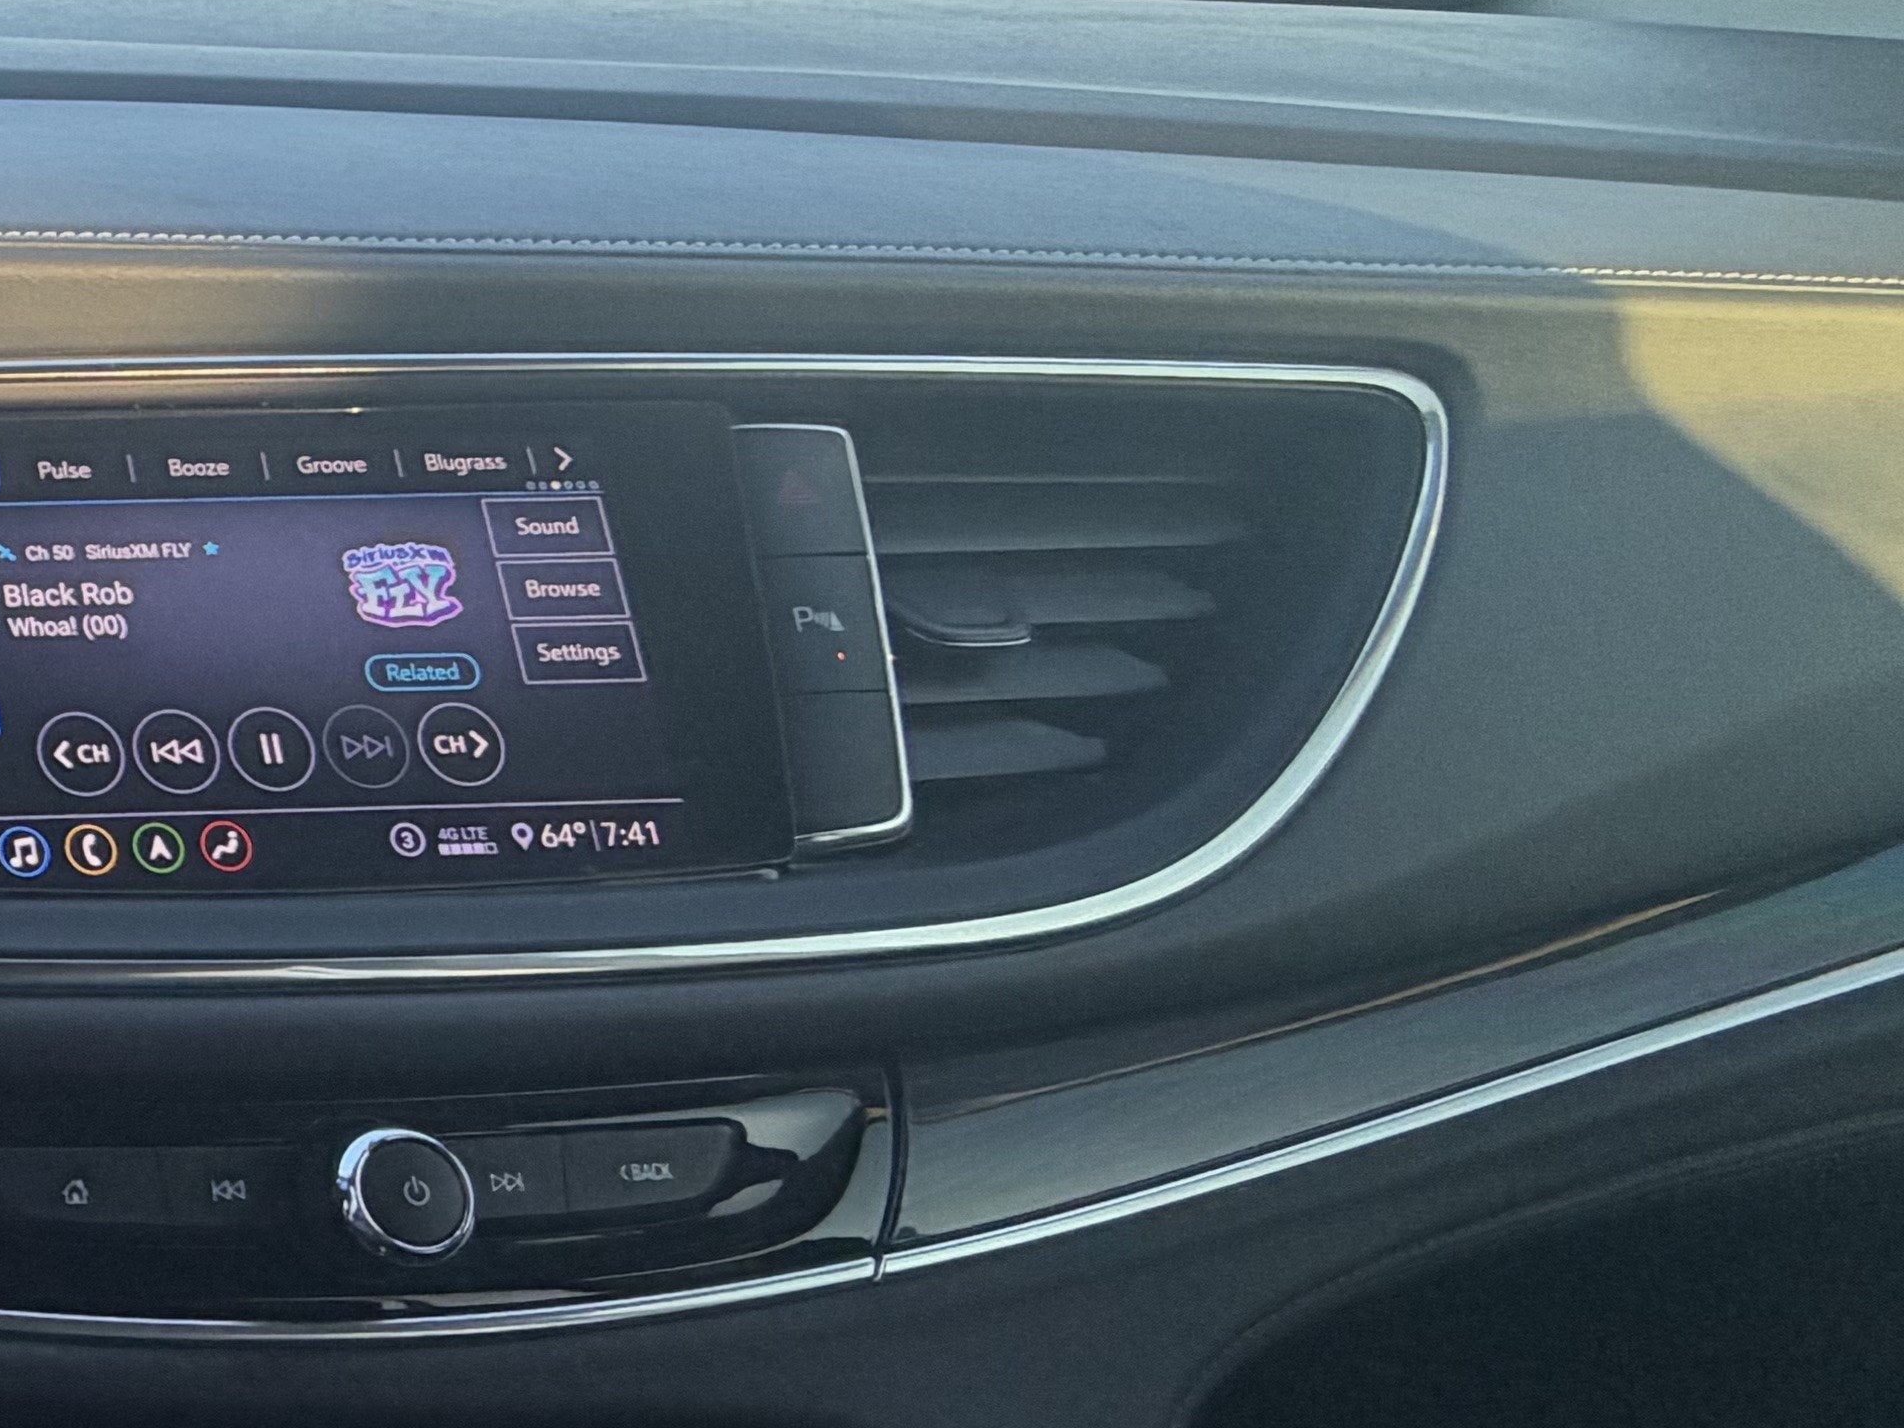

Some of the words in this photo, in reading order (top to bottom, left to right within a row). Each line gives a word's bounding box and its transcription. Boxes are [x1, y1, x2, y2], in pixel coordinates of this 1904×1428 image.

[37, 459, 92, 481] Pulse
[167, 457, 230, 478] Booze
[297, 455, 368, 475] Groove
[424, 452, 508, 477] Blugrass
[515, 515, 580, 537] Sound
[25, 545, 50, 562] Ch
[53, 544, 75, 561] 50
[86, 542, 159, 561] SiriusXM
[161, 541, 193, 559] FLY
[3, 582, 78, 609] Black
[82, 580, 134, 607] Rob
[354, 564, 451, 618] FLY
[525, 578, 601, 599] Browse
[6, 615, 78, 638] Whoa!
[82, 613, 129, 641] (00)
[536, 641, 622, 667] Settings
[387, 662, 460, 681] Related
[76, 743, 110, 764] CH
[433, 734, 467, 755] CH
[401, 831, 414, 849] 3
[437, 827, 460, 840] 4G
[461, 826, 488, 840] LTE
[600, 820, 661, 848] 7:41
